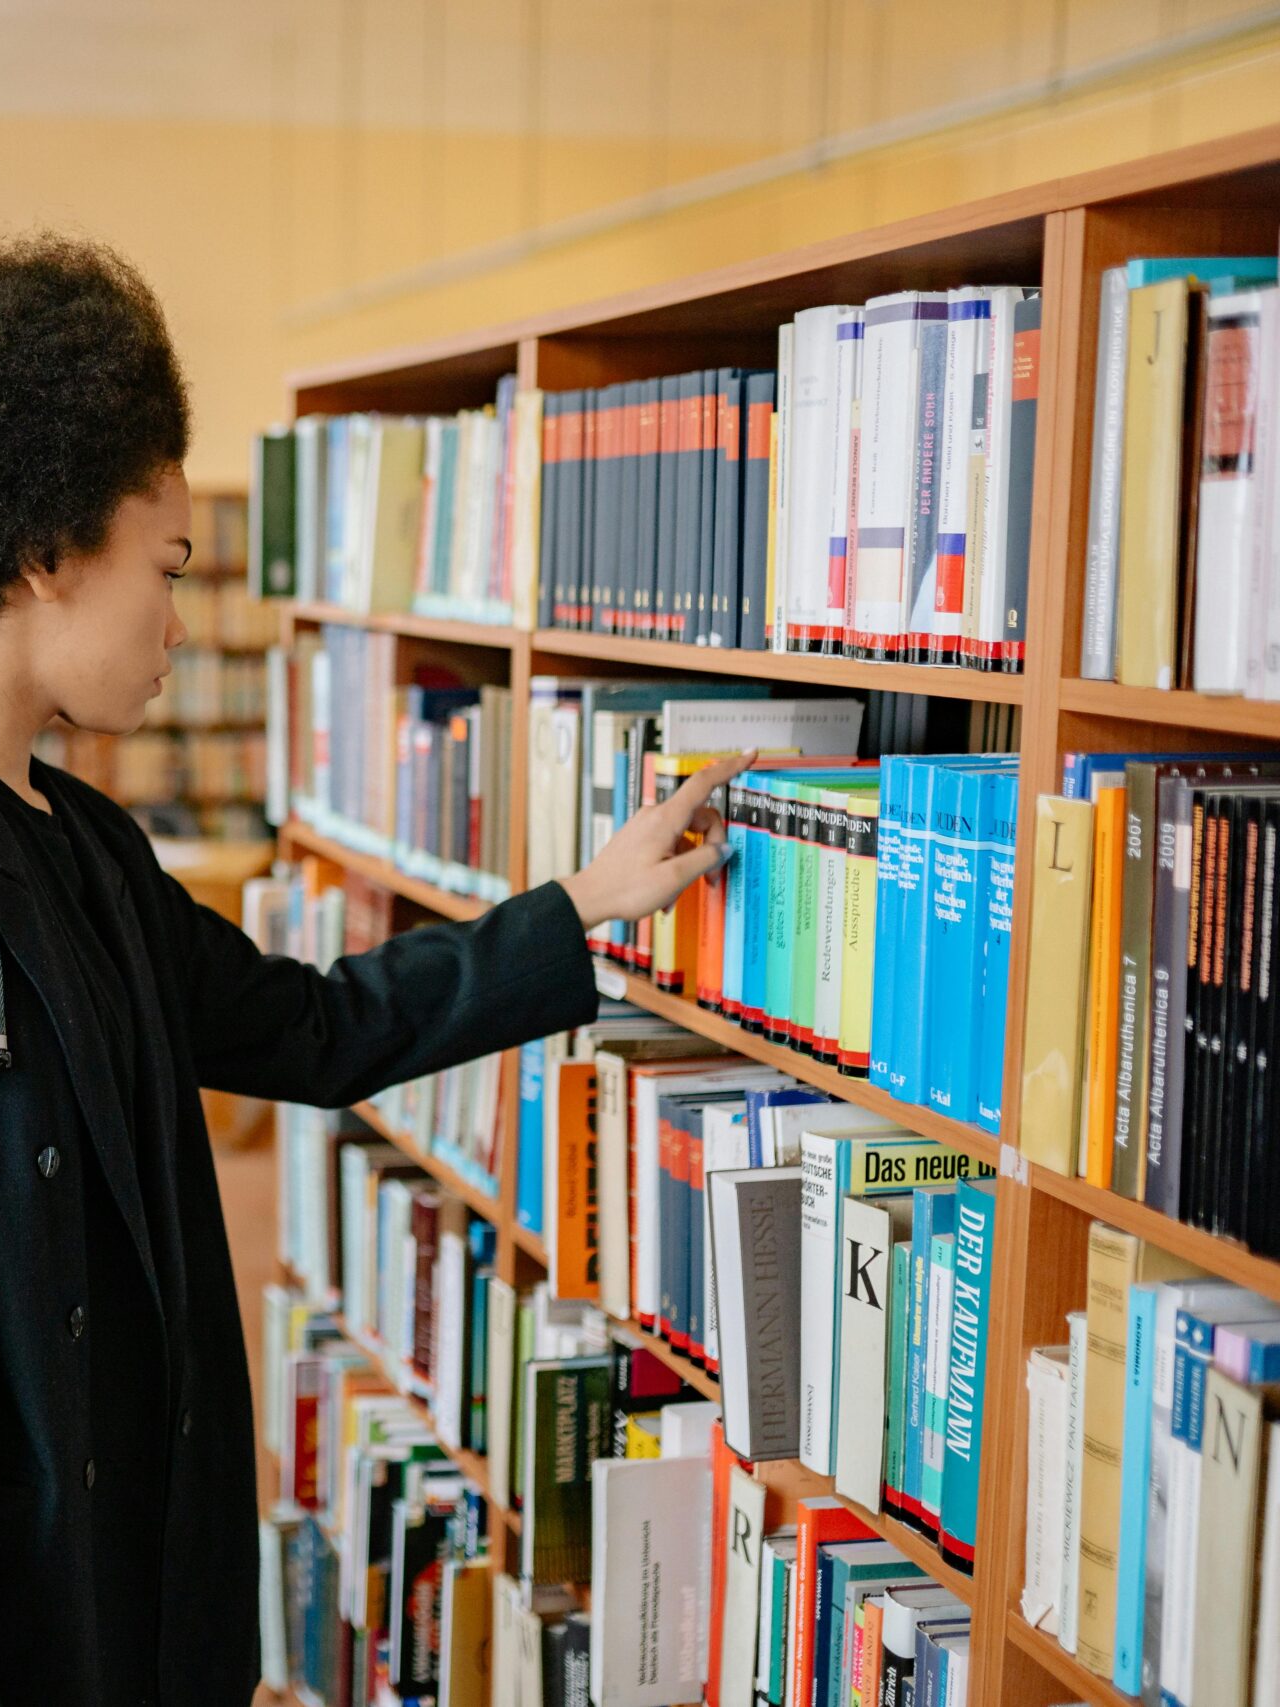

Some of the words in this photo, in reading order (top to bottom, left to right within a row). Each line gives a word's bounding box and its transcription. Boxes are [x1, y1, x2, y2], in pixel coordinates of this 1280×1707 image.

[1108, 305, 1124, 406] SLOVENISTIKE
[1146, 310, 1163, 365] J
[924, 392, 935, 427] SOHN
[1106, 410, 1118, 425] IN
[921, 433, 934, 485] ANDERE
[945, 446, 953, 470] Geld
[850, 477, 858, 518] BENNETT
[920, 489, 931, 515] DER
[1095, 530, 1111, 656] INFRASTRUKTURA
[776, 818, 781, 831] 9
[802, 823, 809, 836] 10
[820, 811, 848, 828] DUDEN
[828, 829, 835, 843] 11
[1128, 813, 1142, 860] 2007
[848, 836, 856, 850] 12
[945, 851, 969, 868] große
[1048, 820, 1074, 873] L
[1158, 823, 1176, 872] 2009
[776, 847, 786, 905] Deutsch
[941, 879, 954, 893] der
[996, 886, 1008, 902] der
[775, 911, 785, 950] gutes
[821, 859, 836, 983] Redewendungen
[848, 868, 861, 952] Aussprüche
[934, 903, 962, 923] Sprache
[942, 921, 948, 935] 3
[995, 933, 1002, 946] 4
[1123, 955, 1137, 966] 7
[1155, 970, 1169, 981] 9
[1117, 975, 1137, 1101] Albaruthenica
[1150, 989, 1169, 1118] Albaruthenica
[1113, 1107, 1131, 1148] Acta
[1147, 1122, 1163, 1165] Acta
[817, 1153, 833, 1165] große
[865, 1151, 907, 1184] Das
[914, 1153, 970, 1181] neue
[750, 1195, 778, 1280] HESSE
[957, 1203, 985, 1275] DER
[845, 1237, 884, 1311] K
[913, 1283, 923, 1303] und
[1134, 1315, 1143, 1376] EKONOMIA
[756, 1292, 787, 1442] HERMANN
[911, 1353, 921, 1386] Kaiser
[946, 1280, 981, 1462] KAUFMANN
[1070, 1335, 1080, 1408] TADEUSZ
[910, 1386, 920, 1427] Gerhard
[1189, 1365, 1202, 1441] MORFOLOGIA
[555, 1375, 578, 1484] MARKTPLATZ
[1068, 1416, 1076, 1451] PAN
[1211, 1394, 1247, 1475] N
[1063, 1461, 1075, 1563] MICKIEWICZ
[641, 1520, 651, 1566] Unterricht
[731, 1507, 754, 1566] R
[799, 1522, 808, 1581] Grammatik
[640, 1569, 649, 1581] im
[650, 1562, 661, 1629] Fremdsprache
[815, 1568, 823, 1620] SPECIMINA
[797, 1582, 806, 1632] deutsche
[650, 1631, 659, 1642] als
[648, 1646, 658, 1685] Deutsch
[885, 1667, 897, 1707] Zürich
